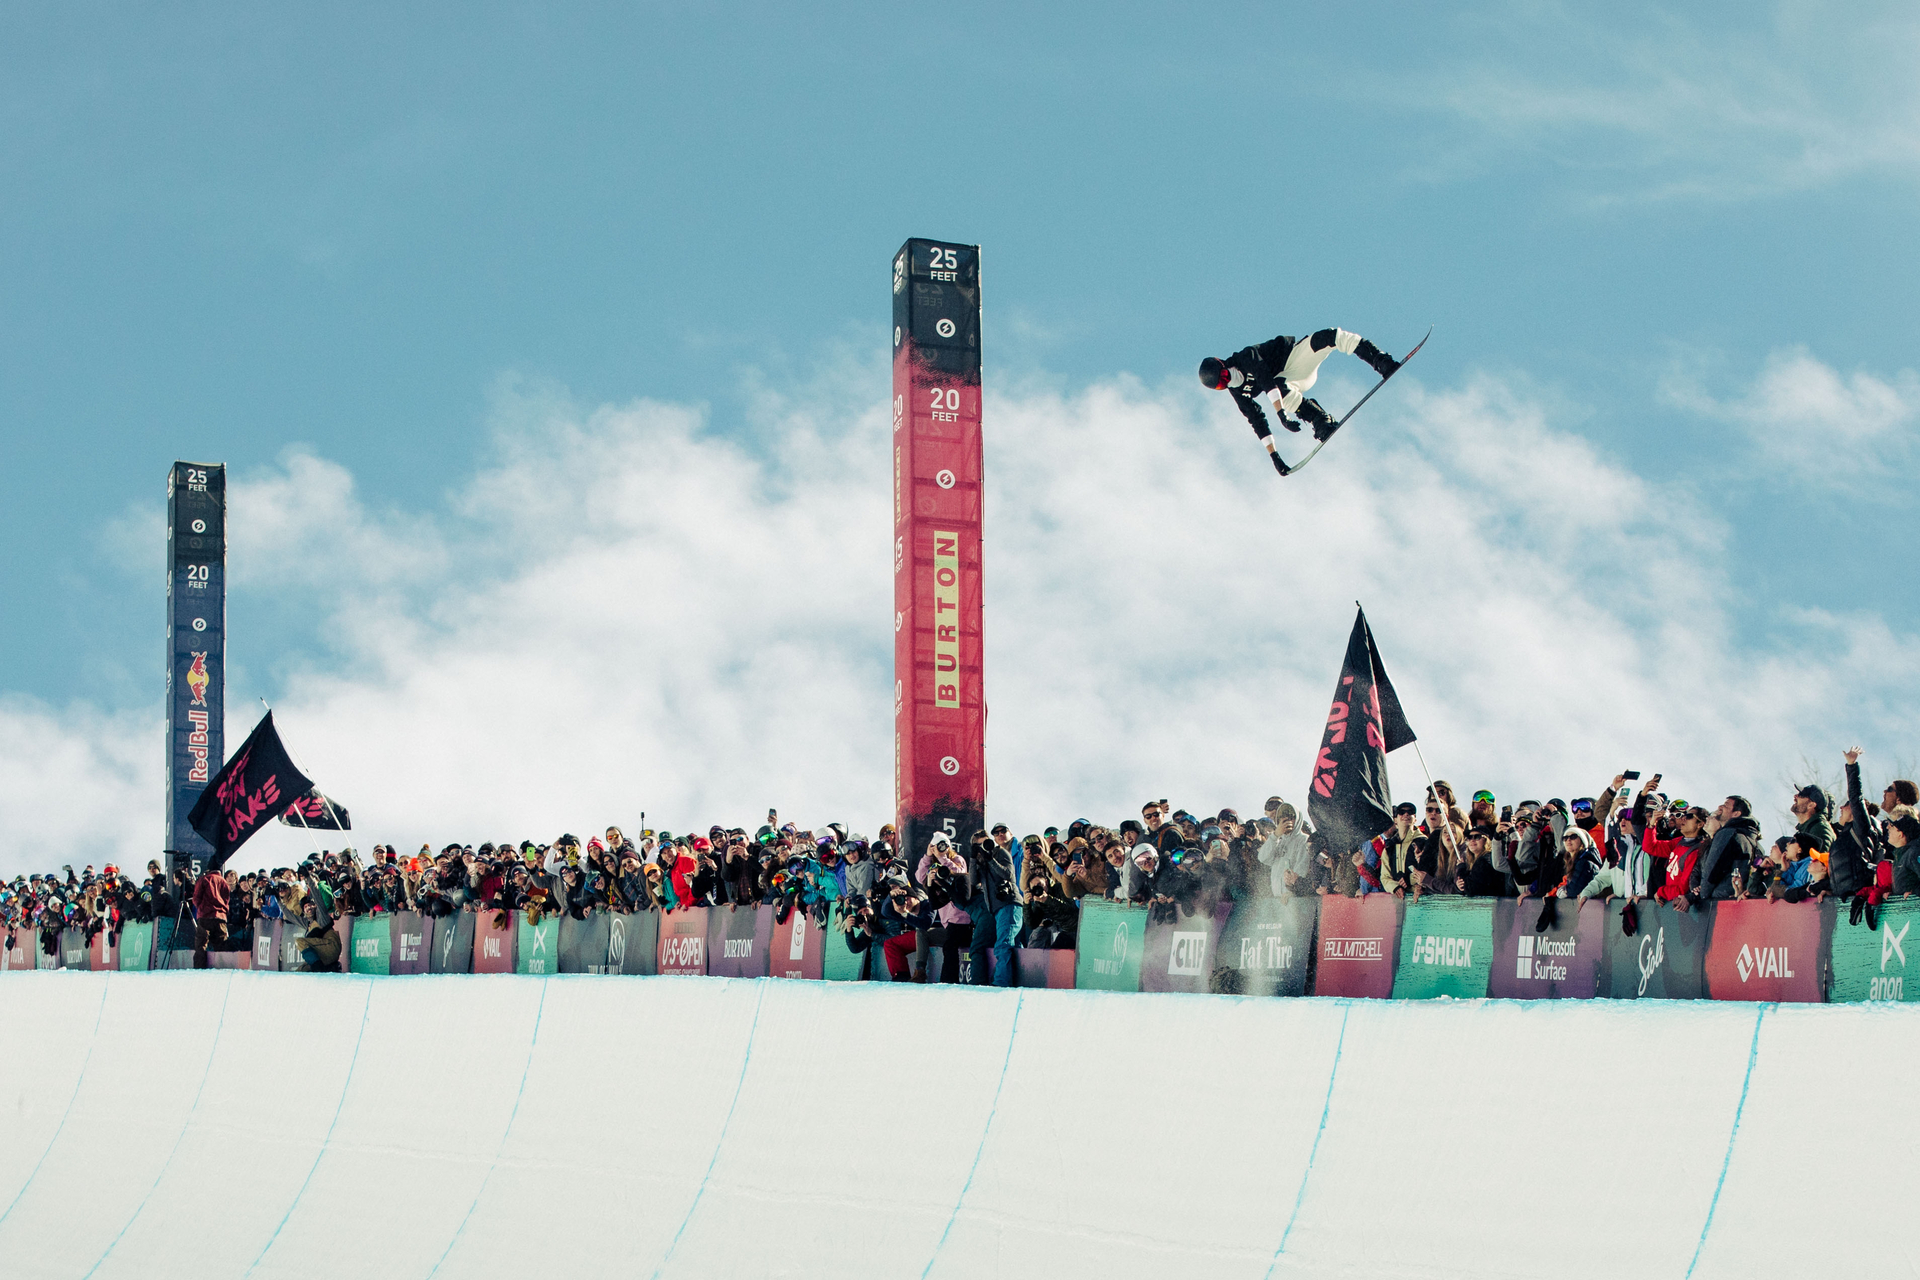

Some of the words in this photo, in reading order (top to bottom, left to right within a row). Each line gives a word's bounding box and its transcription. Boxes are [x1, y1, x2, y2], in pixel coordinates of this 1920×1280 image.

[930, 247, 958, 270] 25
[930, 271, 958, 282] FEET
[930, 387, 960, 411] 20
[931, 411, 959, 422] FEET
[187, 469, 208, 484] 25
[188, 484, 208, 492] FEET
[187, 564, 209, 581] 20
[188, 581, 208, 589] FEET
[936, 537, 957, 702] BURTON
[227, 774, 281, 842] JAKE
[943, 817, 957, 840] 5
[191, 860, 202, 876] 5
[355, 938, 380, 958] G-SHOCK
[407, 932, 422, 946] Microsoft
[488, 938, 502, 957] VAIL
[723, 938, 753, 958] BURTON
[1324, 941, 1344, 957] PAUL
[1344, 941, 1383, 957] MITCHELL
[1536, 936, 1576, 957] Microsoft
[406, 948, 419, 961] Surface
[1239, 937, 1262, 970] Fat
[1266, 936, 1293, 969] Tire
[1412, 936, 1473, 968] G-SHOCK
[1534, 960, 1567, 981] Surface
[1754, 947, 1792, 978] VAIL
[1869, 976, 1903, 1001] anon
